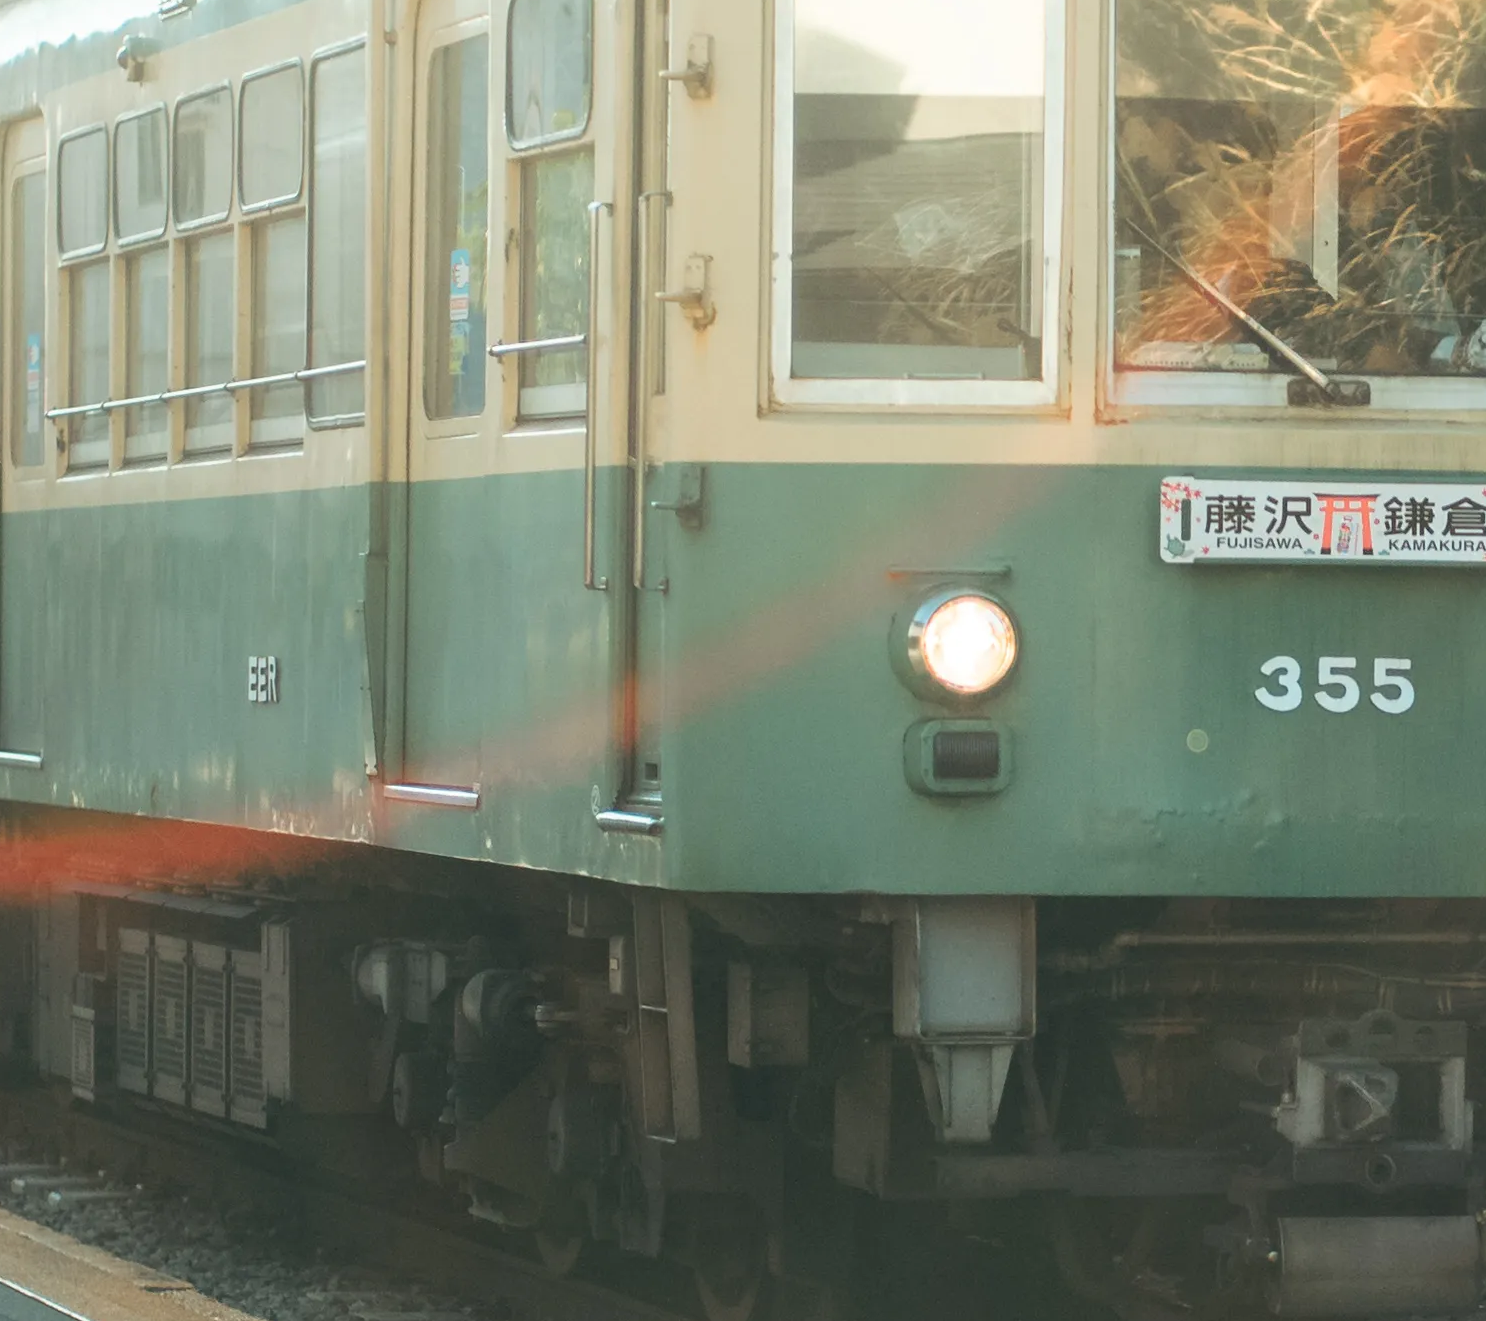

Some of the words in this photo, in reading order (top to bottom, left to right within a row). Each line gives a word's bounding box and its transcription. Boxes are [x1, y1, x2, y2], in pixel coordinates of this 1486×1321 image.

[1204, 494, 1313, 535] 藤沢
[1216, 537, 1303, 550] FUJISAWA
[1388, 538, 1486, 552] KAMAKURA
[248, 655, 277, 703] EER
[1254, 655, 1416, 714] 355
